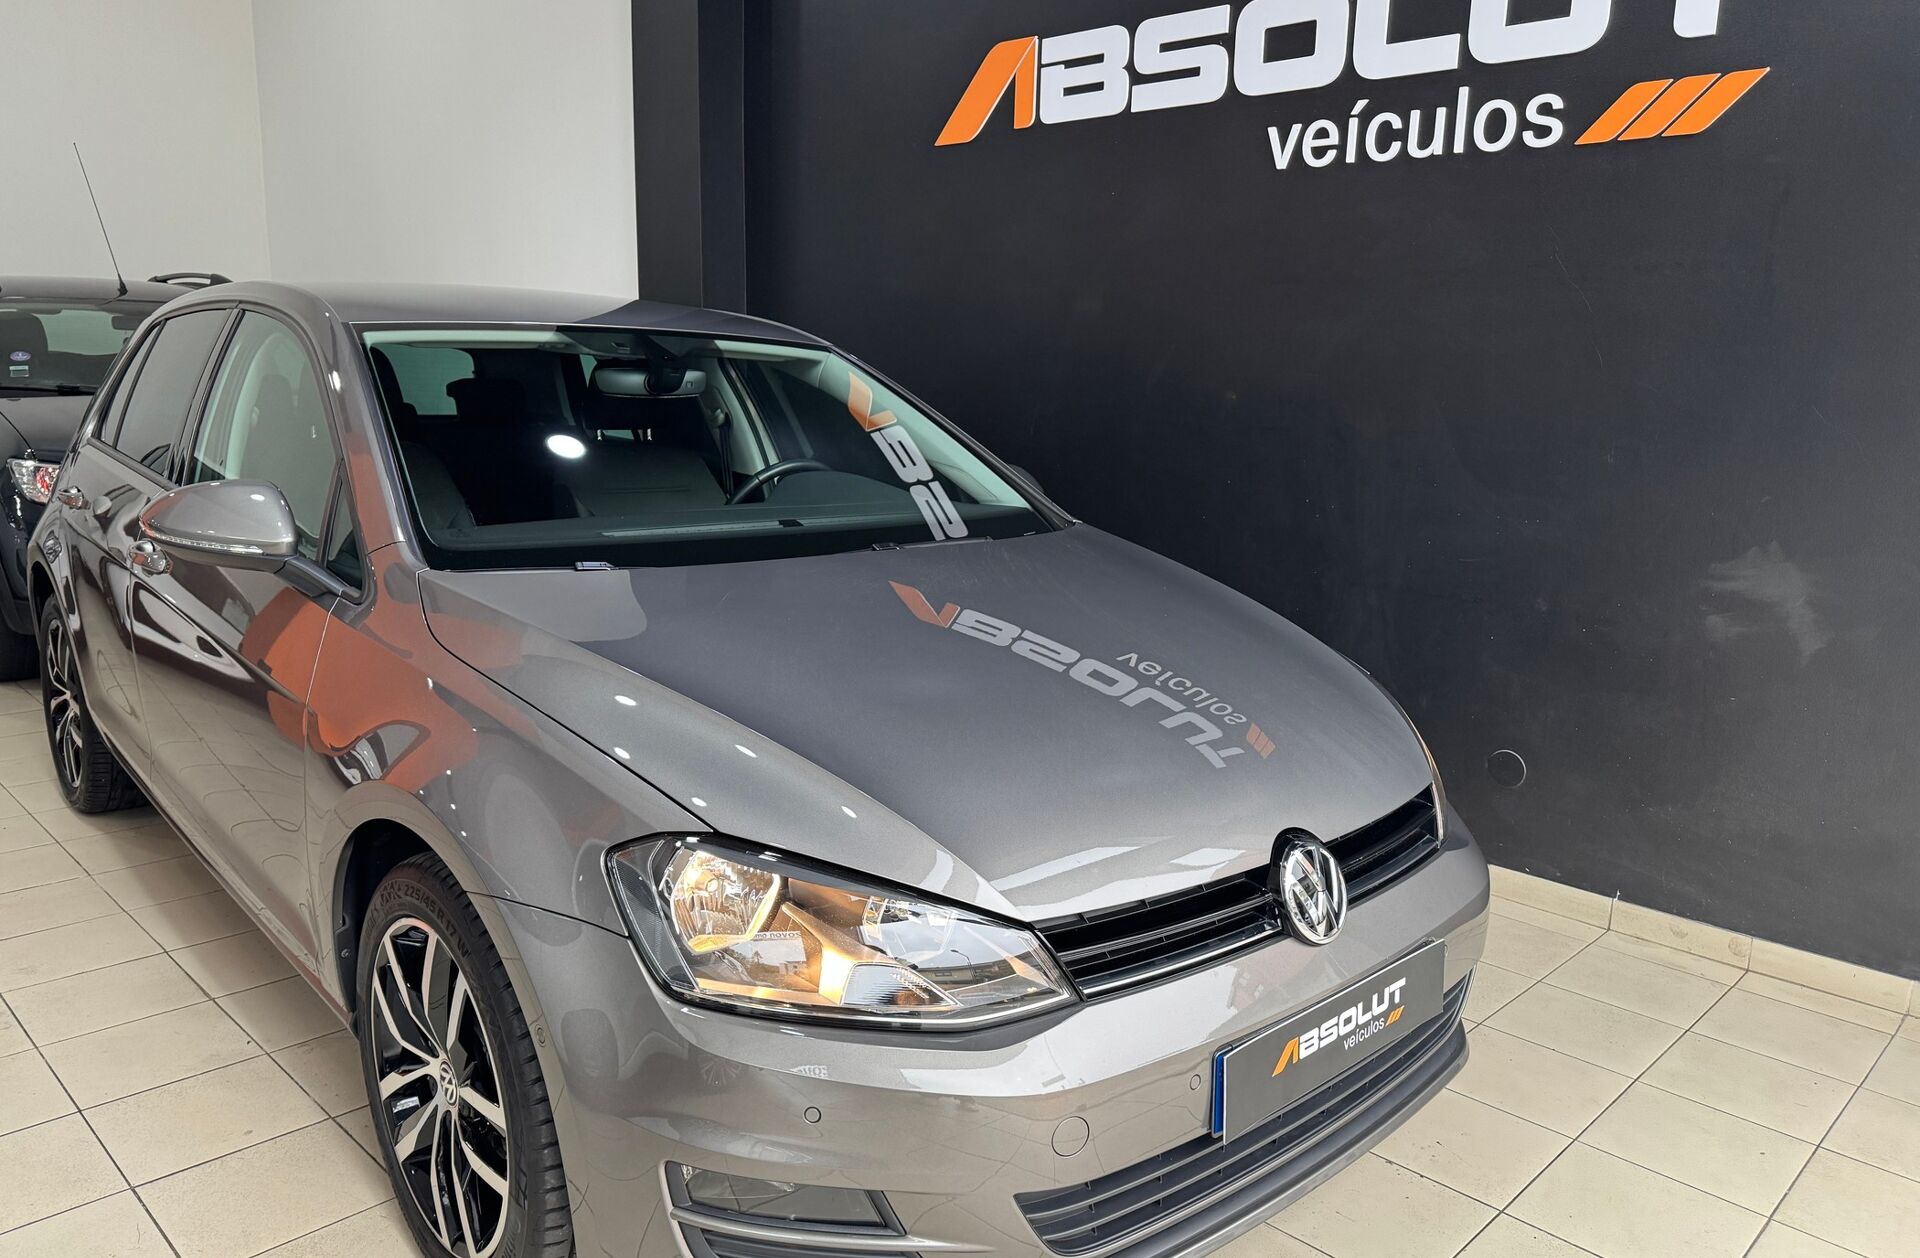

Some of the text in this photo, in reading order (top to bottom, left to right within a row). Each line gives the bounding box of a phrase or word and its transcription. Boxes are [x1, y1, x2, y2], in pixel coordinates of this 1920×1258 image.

[1267, 86, 1565, 170] veículos
[1272, 977, 1406, 1077] ABSOLUT
[1343, 1017, 1386, 1051] veículos
